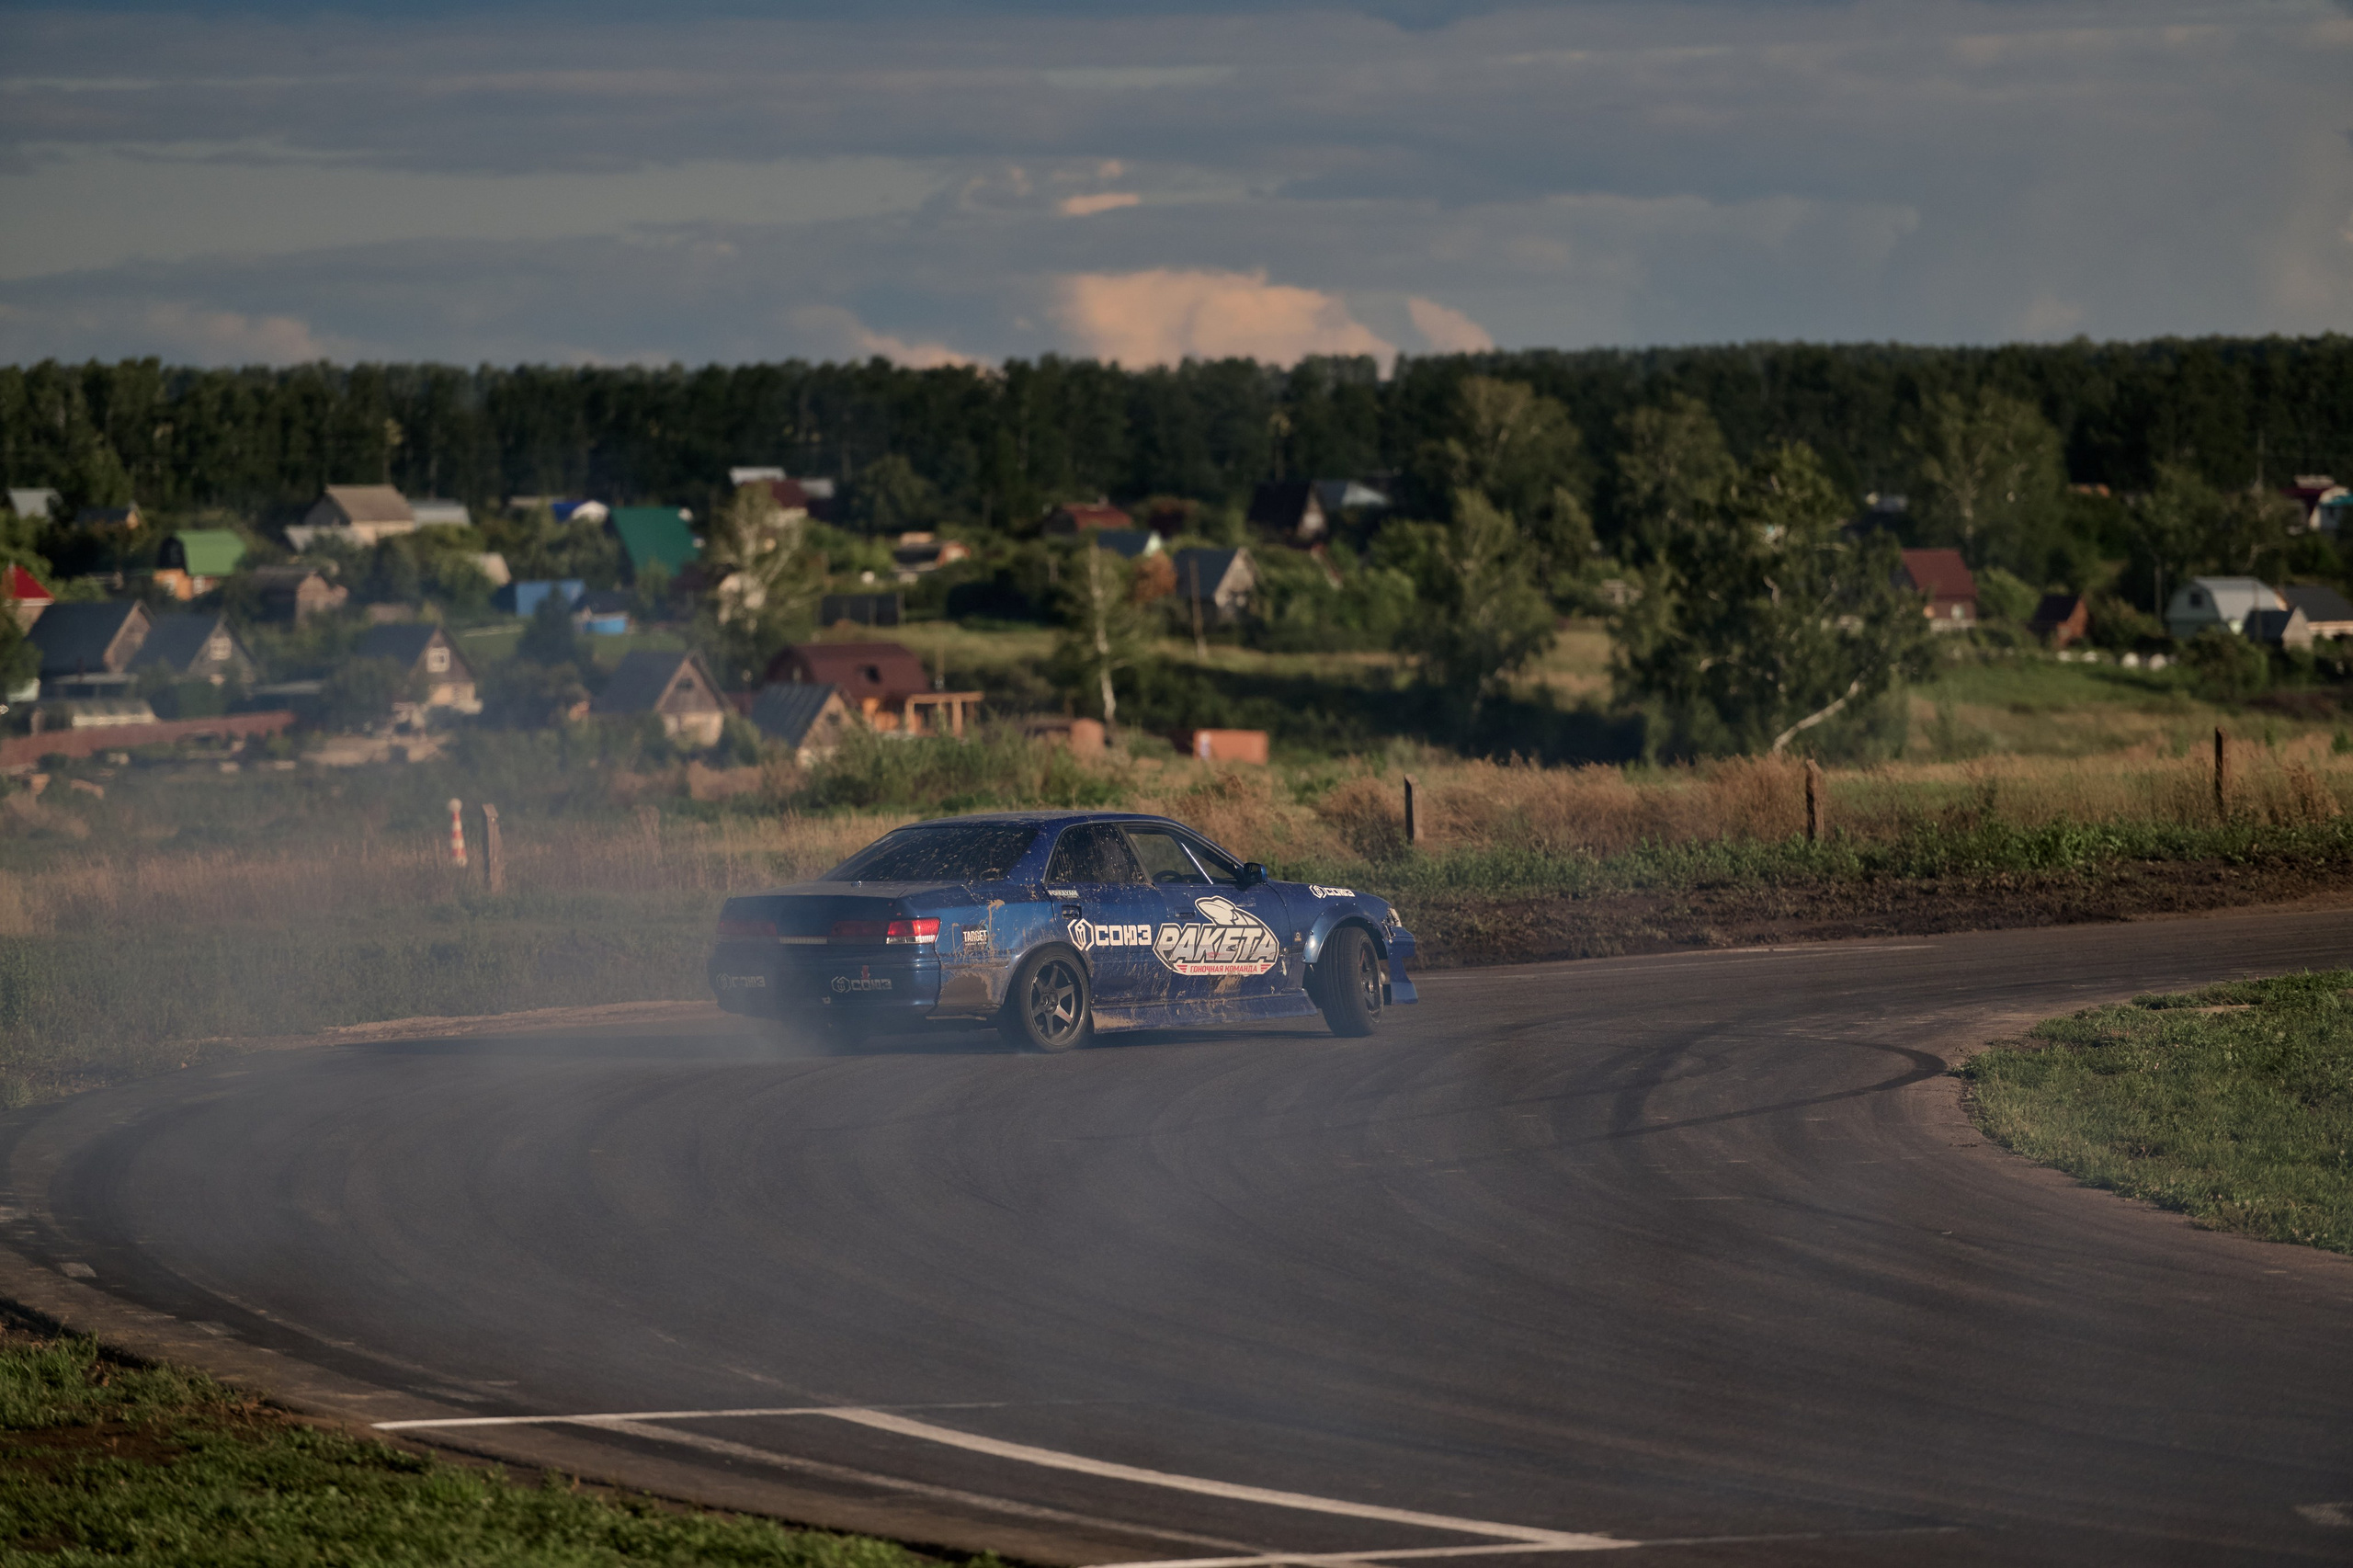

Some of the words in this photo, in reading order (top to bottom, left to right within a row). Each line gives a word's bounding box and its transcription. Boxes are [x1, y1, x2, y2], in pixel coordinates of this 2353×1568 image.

[962, 930, 987, 942] TARGET
[1095, 924, 1152, 947] СОЮЗ
[1159, 924, 1277, 963] РАКЕТА
[1189, 965, 1224, 973] ГОНОЧНАЯ
[1224, 964, 1258, 972] КОМАНДА
[850, 978, 892, 991] СОЮЗ
